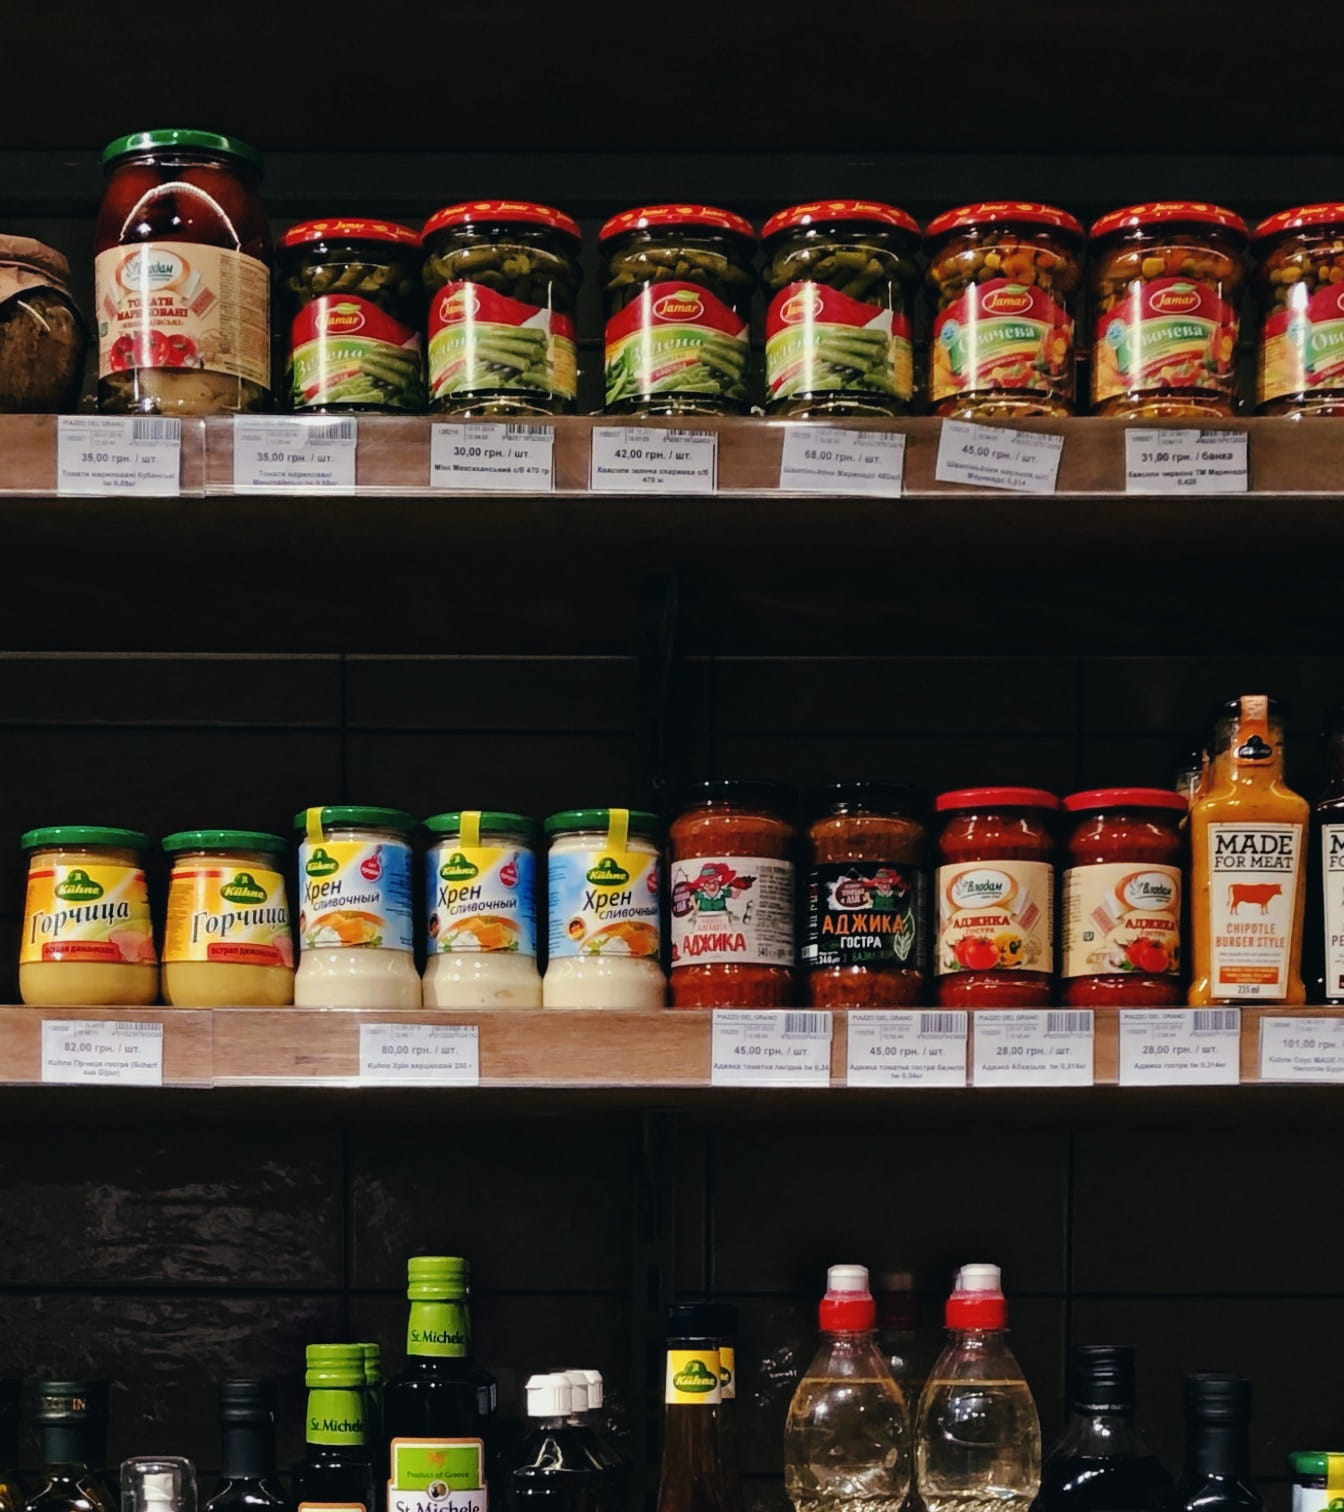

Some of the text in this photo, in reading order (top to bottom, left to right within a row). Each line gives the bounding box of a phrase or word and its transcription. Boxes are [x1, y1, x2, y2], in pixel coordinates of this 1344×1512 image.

[662, 301, 699, 315] Jamar
[991, 293, 1029, 310] Jamar
[1156, 293, 1198, 309] Jamar
[1216, 834, 1293, 855] MADE
[1215, 855, 1294, 869] FOR MEAT
[58, 884, 100, 896] Kühne
[439, 886, 482, 906] Хрен
[583, 890, 633, 913] Хрен
[31, 901, 129, 943] Горчица
[193, 906, 286, 942] Горчица
[823, 913, 903, 936] АДЖИКА
[953, 915, 1010, 927] АДЖИКА
[1227, 923, 1276, 935] CHIPOTLE
[683, 933, 747, 955] АДЖИКА
[841, 934, 882, 949] ГОСТРА
[674, 1374, 714, 1387] Kühne
